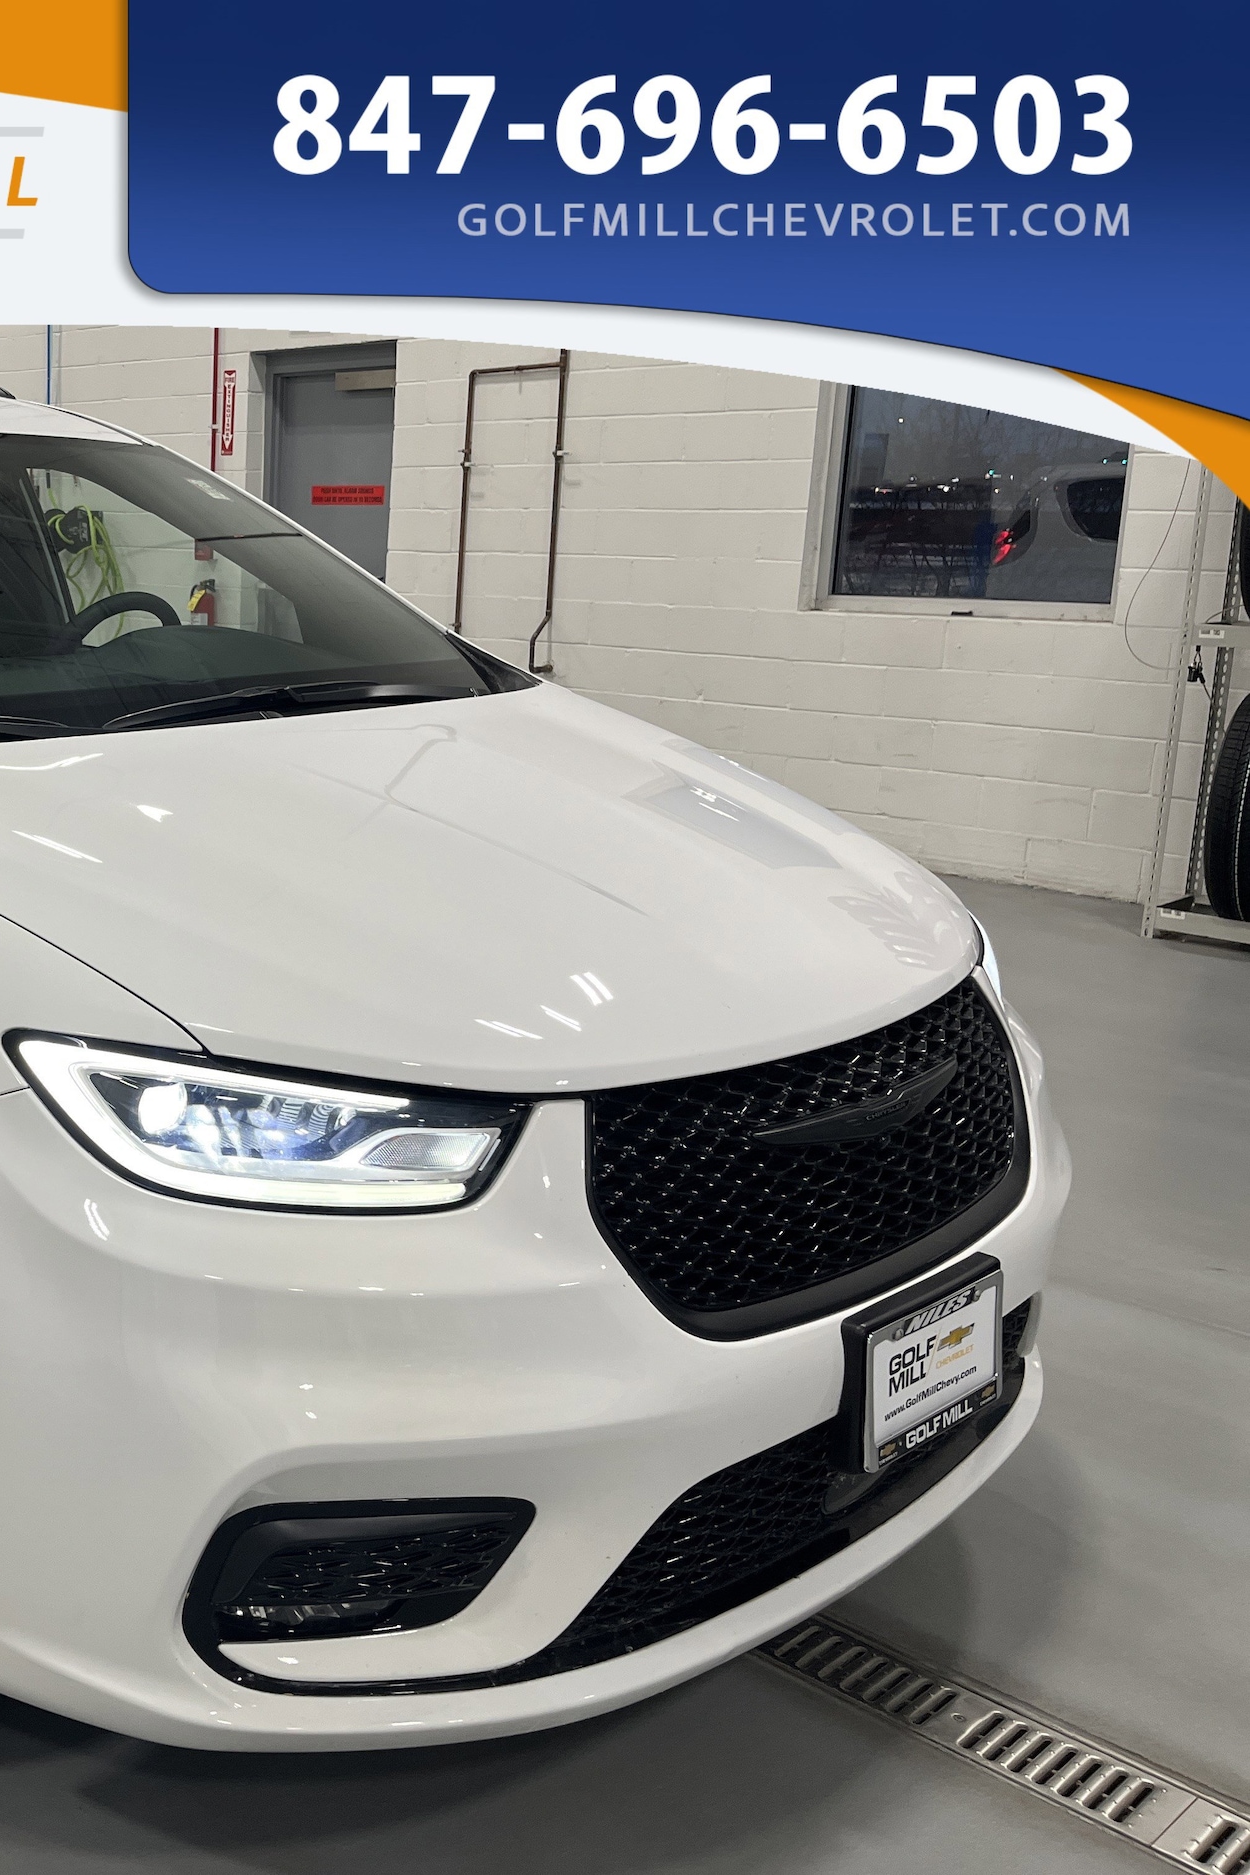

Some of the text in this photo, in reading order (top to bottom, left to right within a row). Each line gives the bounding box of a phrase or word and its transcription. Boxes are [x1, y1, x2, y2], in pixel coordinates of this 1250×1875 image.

[865, 1101, 906, 1121] CHRYSLER
[905, 1288, 971, 1334] NILES
[888, 1334, 938, 1376] GOLF
[935, 1344, 974, 1370] CHEVROLET
[884, 1365, 977, 1422] www.GolfMillChevy.com
[888, 1365, 928, 1397] MILL
[905, 1399, 973, 1449] GOLF MILL
